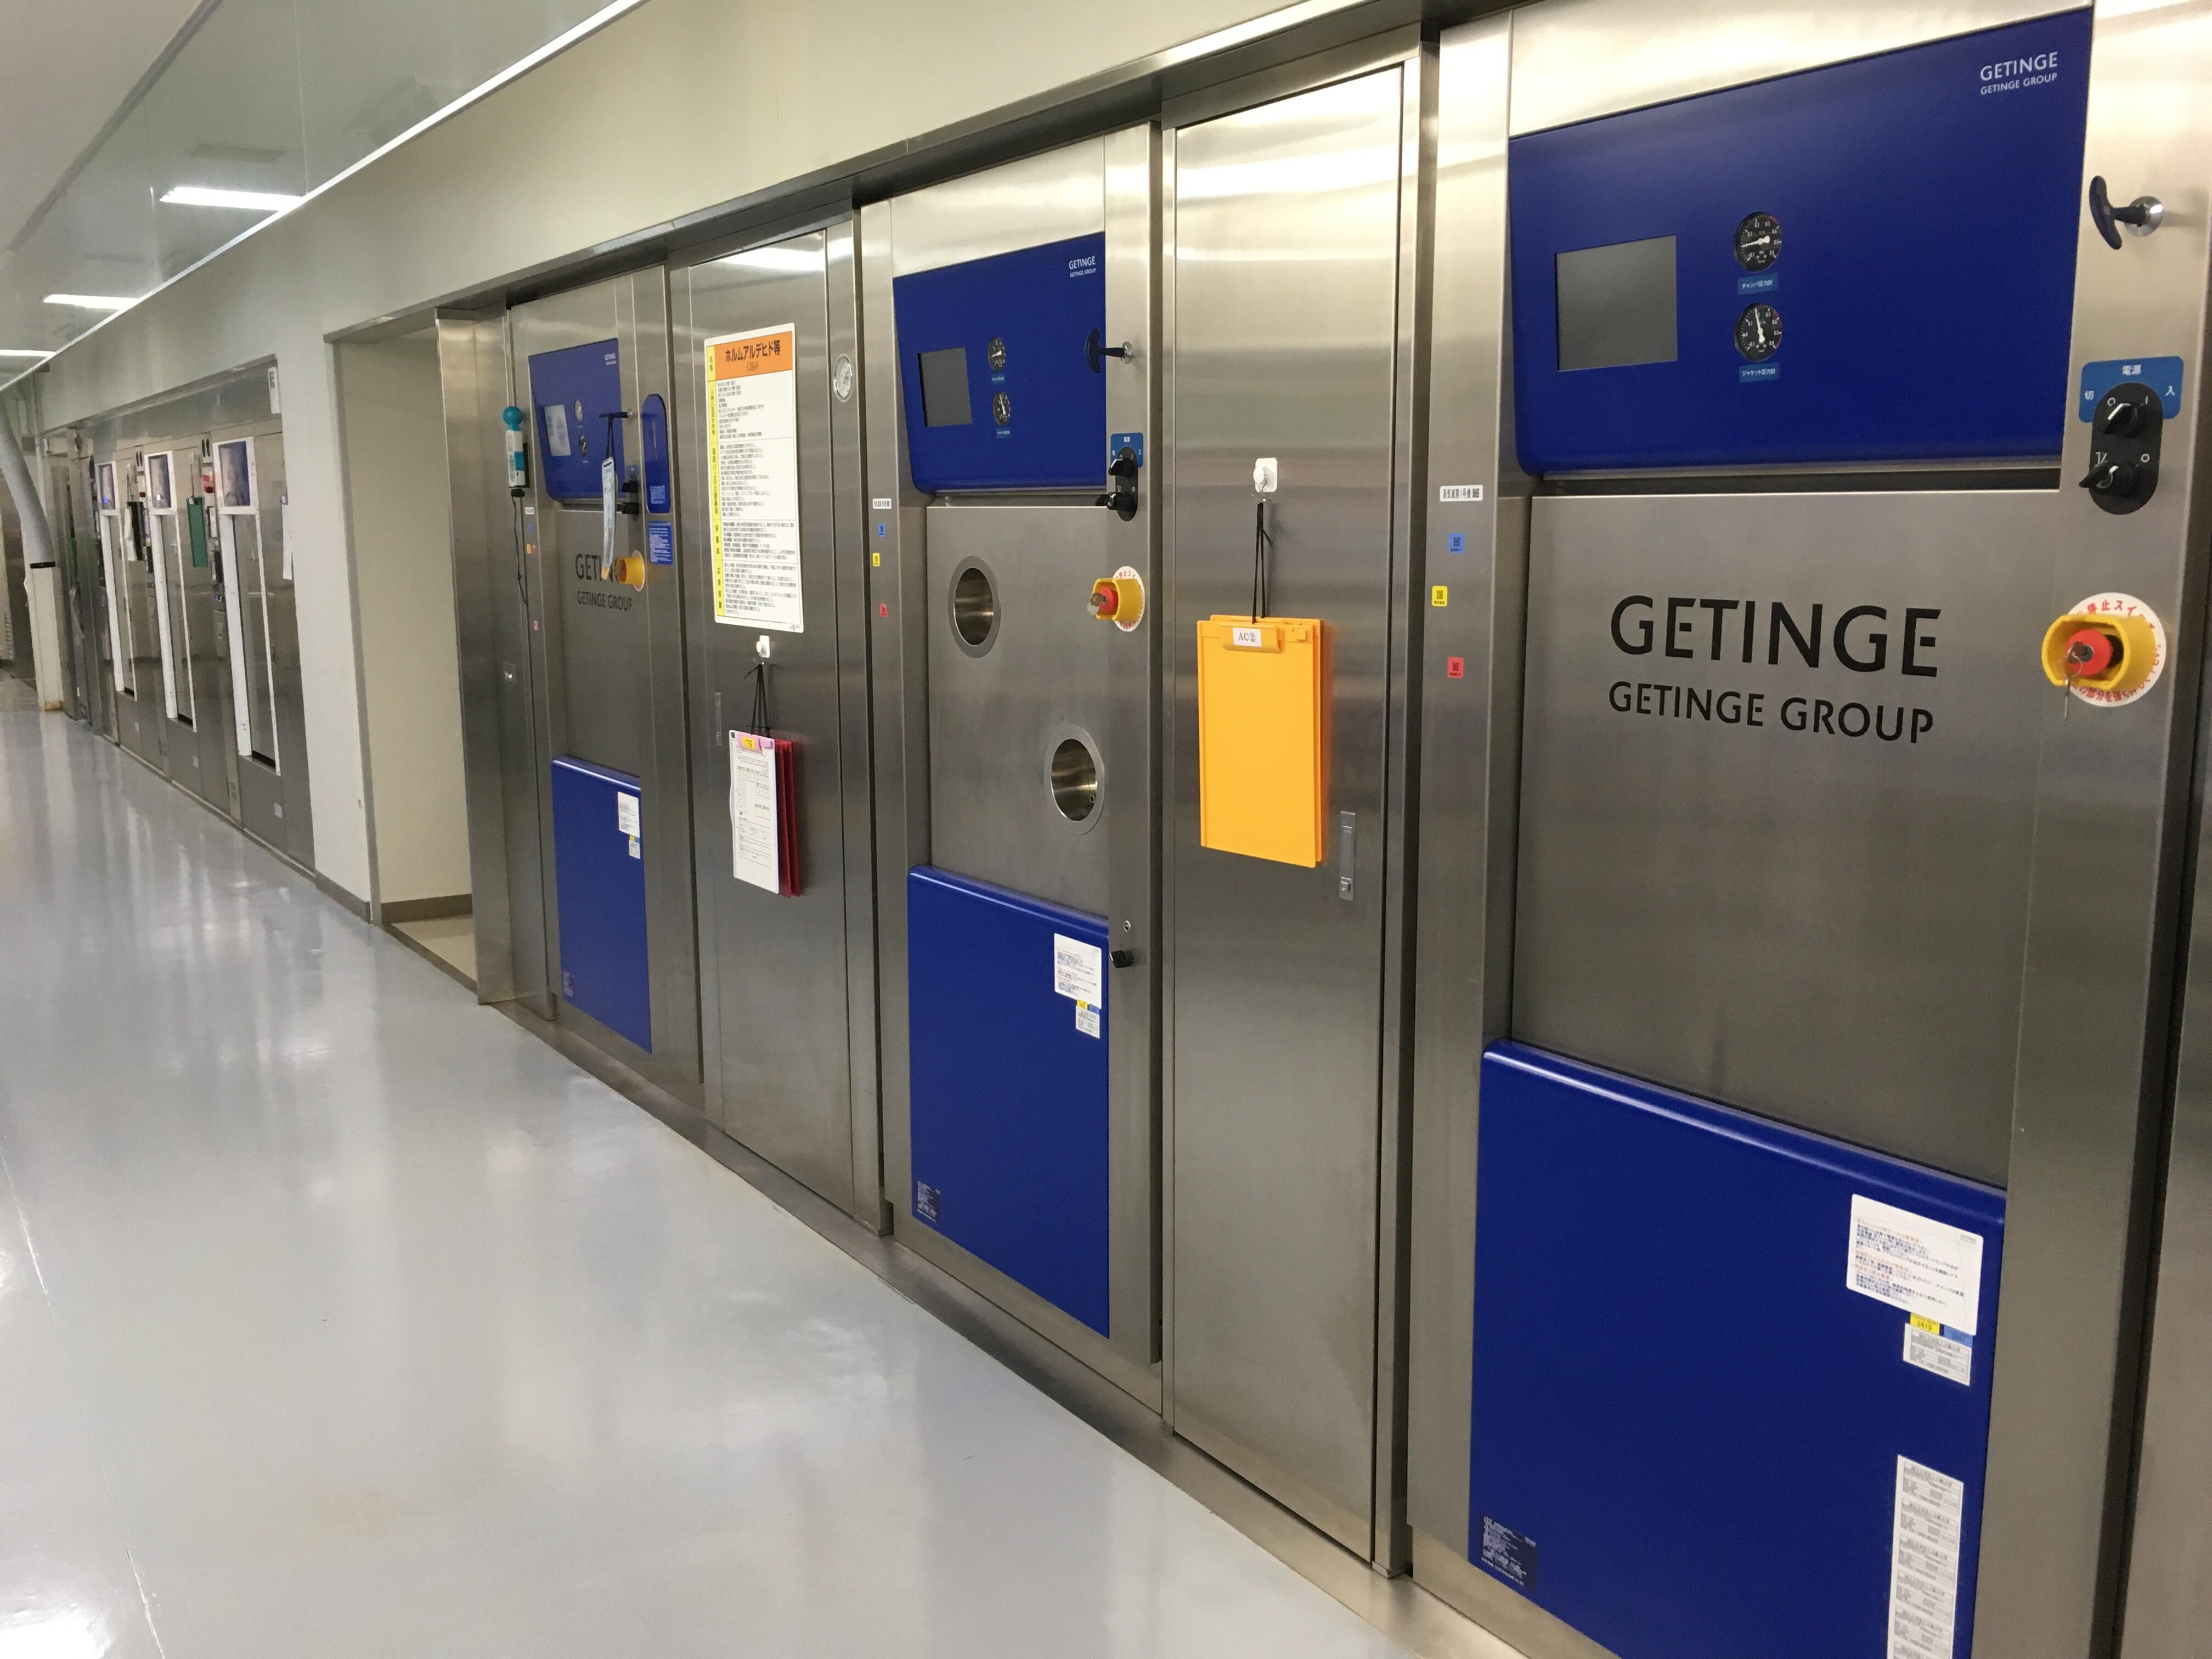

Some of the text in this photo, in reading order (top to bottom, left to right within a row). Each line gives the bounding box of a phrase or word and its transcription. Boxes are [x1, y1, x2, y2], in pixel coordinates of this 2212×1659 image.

[1980, 51, 2058, 81] GETINGE
[1980, 72, 2058, 95] GETINGE GROUP
[1069, 256, 1096, 270] GETINGE
[725, 339, 781, 363] ホルムアルデヒド等
[2121, 364, 2142, 376] 電源
[2084, 390, 2094, 400] 切
[2164, 385, 2176, 397] 入
[577, 591, 633, 612] GETINGE GROUP
[1610, 595, 1942, 678] GETINGE
[1609, 681, 1933, 743] GETINGE GROUP
